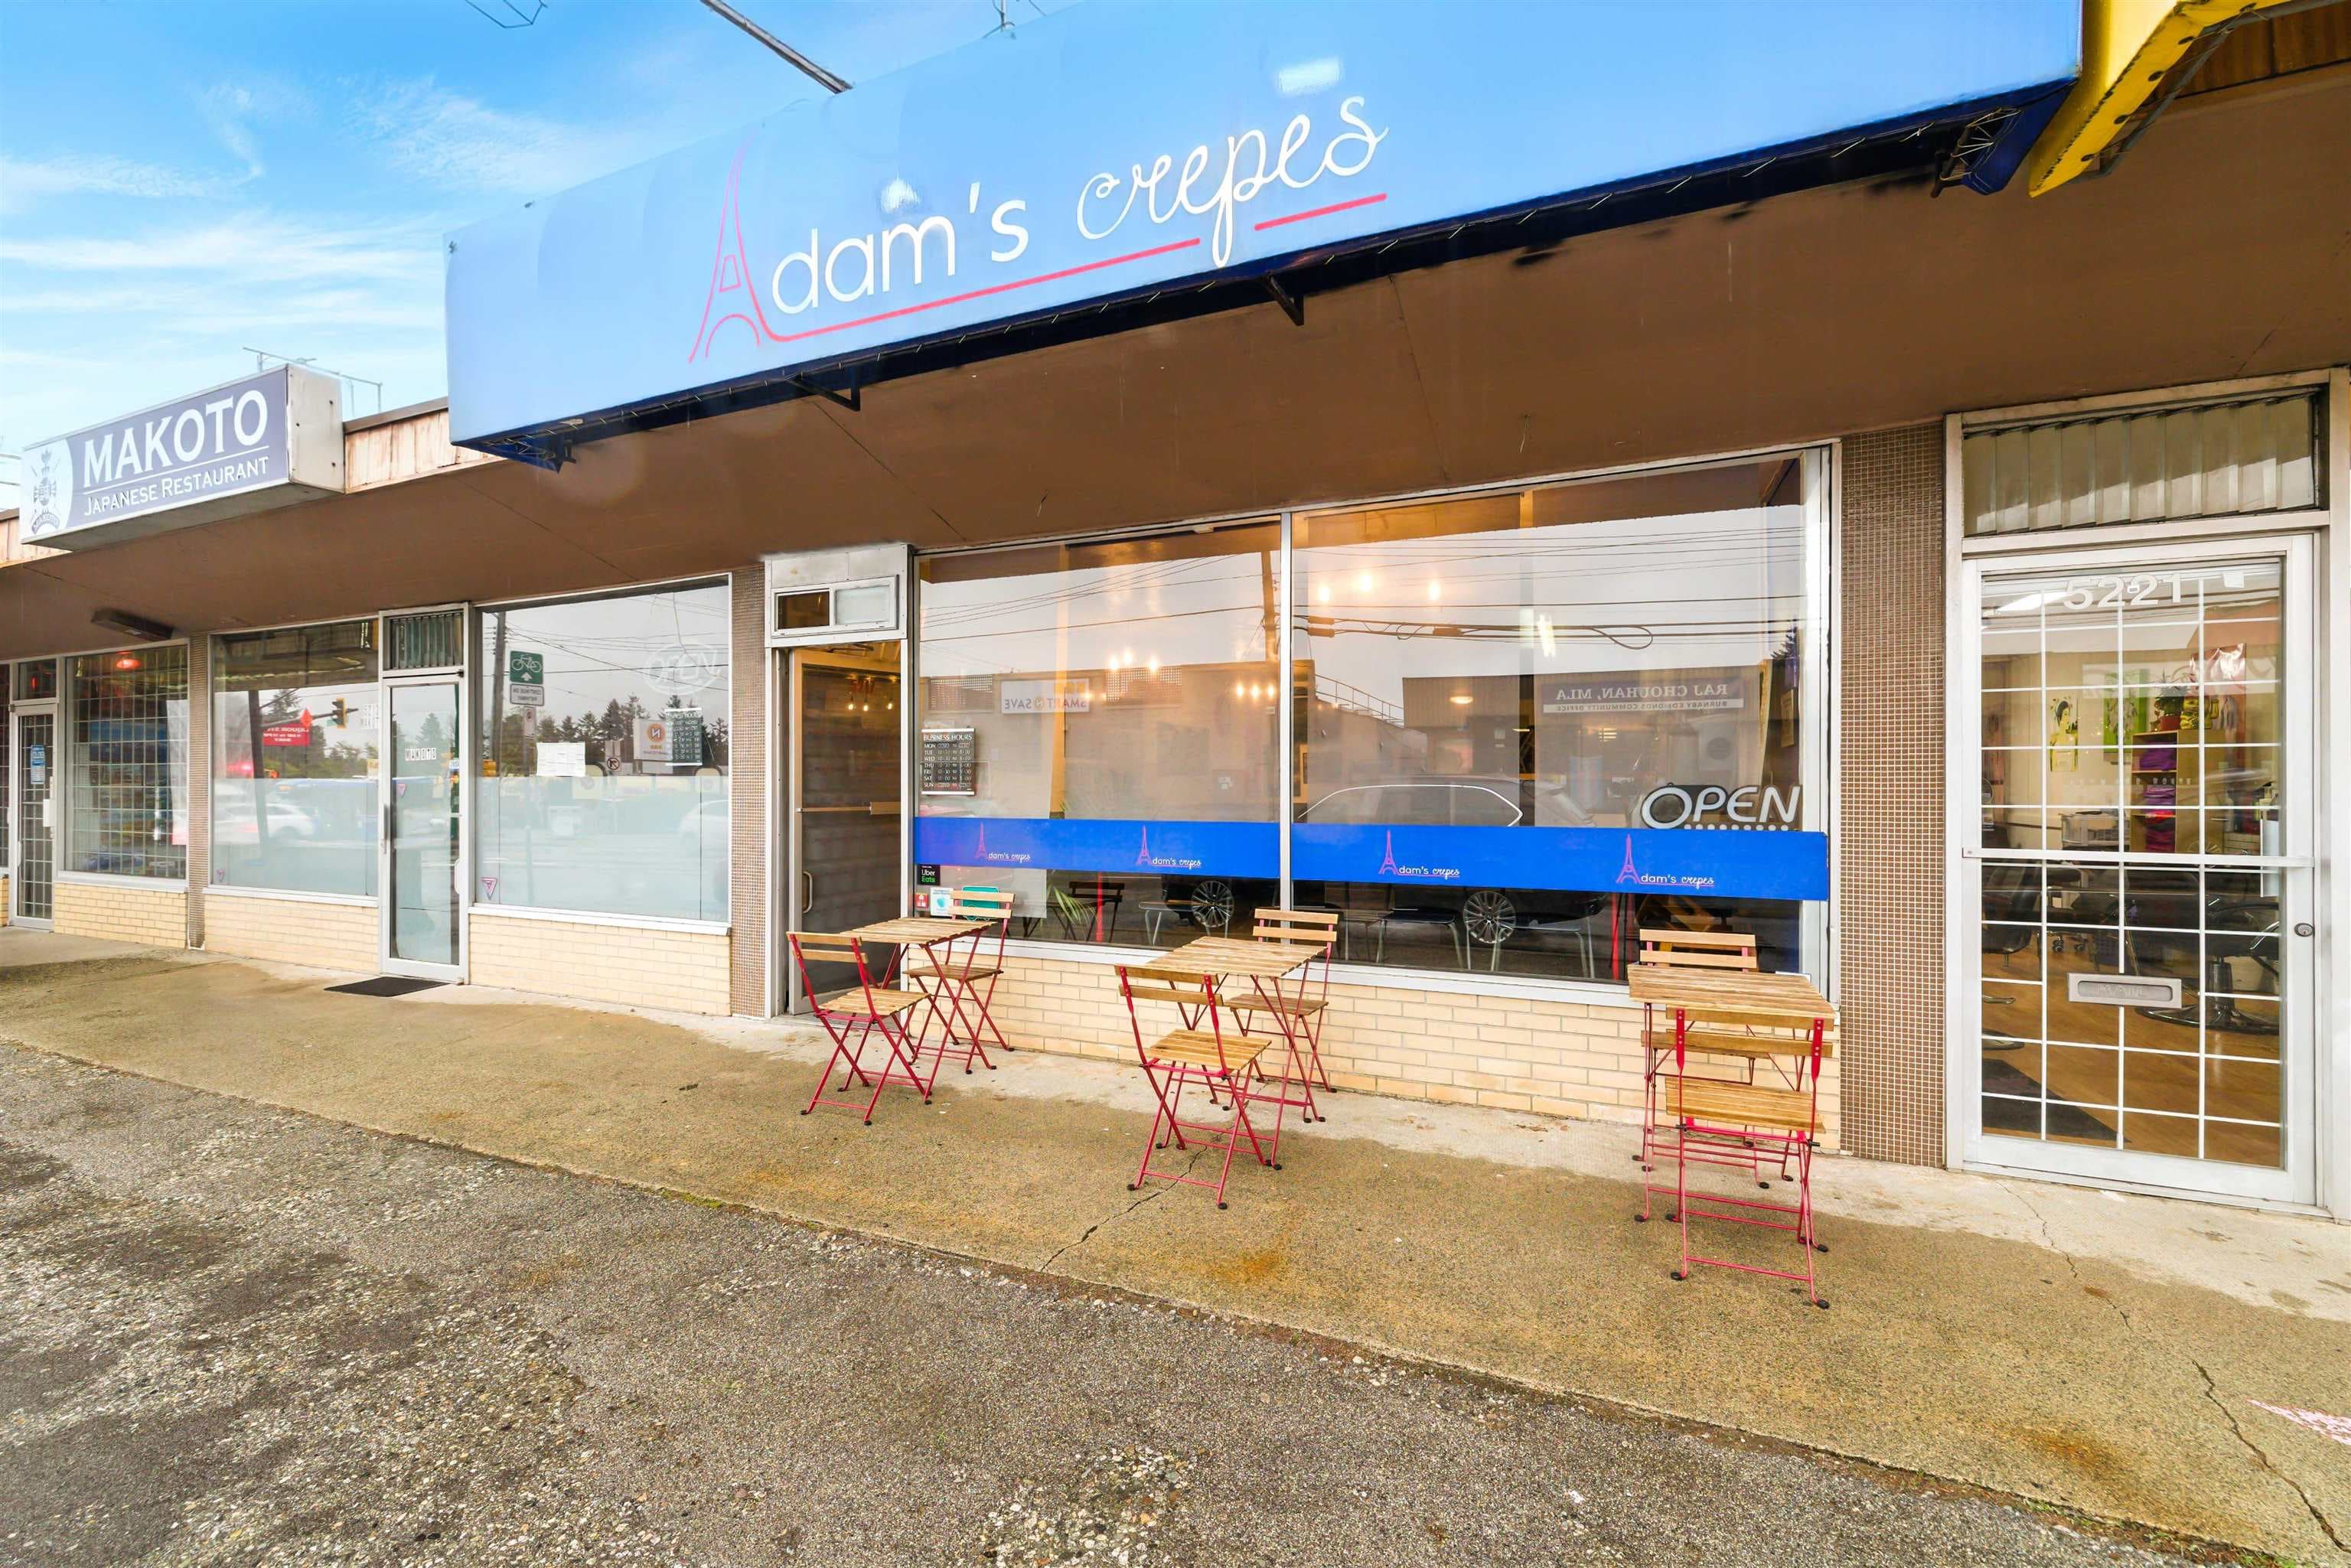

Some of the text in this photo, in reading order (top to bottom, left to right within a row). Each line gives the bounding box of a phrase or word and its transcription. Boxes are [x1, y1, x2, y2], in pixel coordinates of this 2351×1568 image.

[1076, 96, 1389, 266] crepes
[83, 390, 268, 488] MAKOTO
[83, 455, 269, 517] JAPANESE RESTAURANT
[2063, 573, 2181, 610] 5221
[1642, 786, 1801, 830] OPEN
[1433, 869, 1460, 880] crepes
[1681, 876, 1714, 889] crepes
